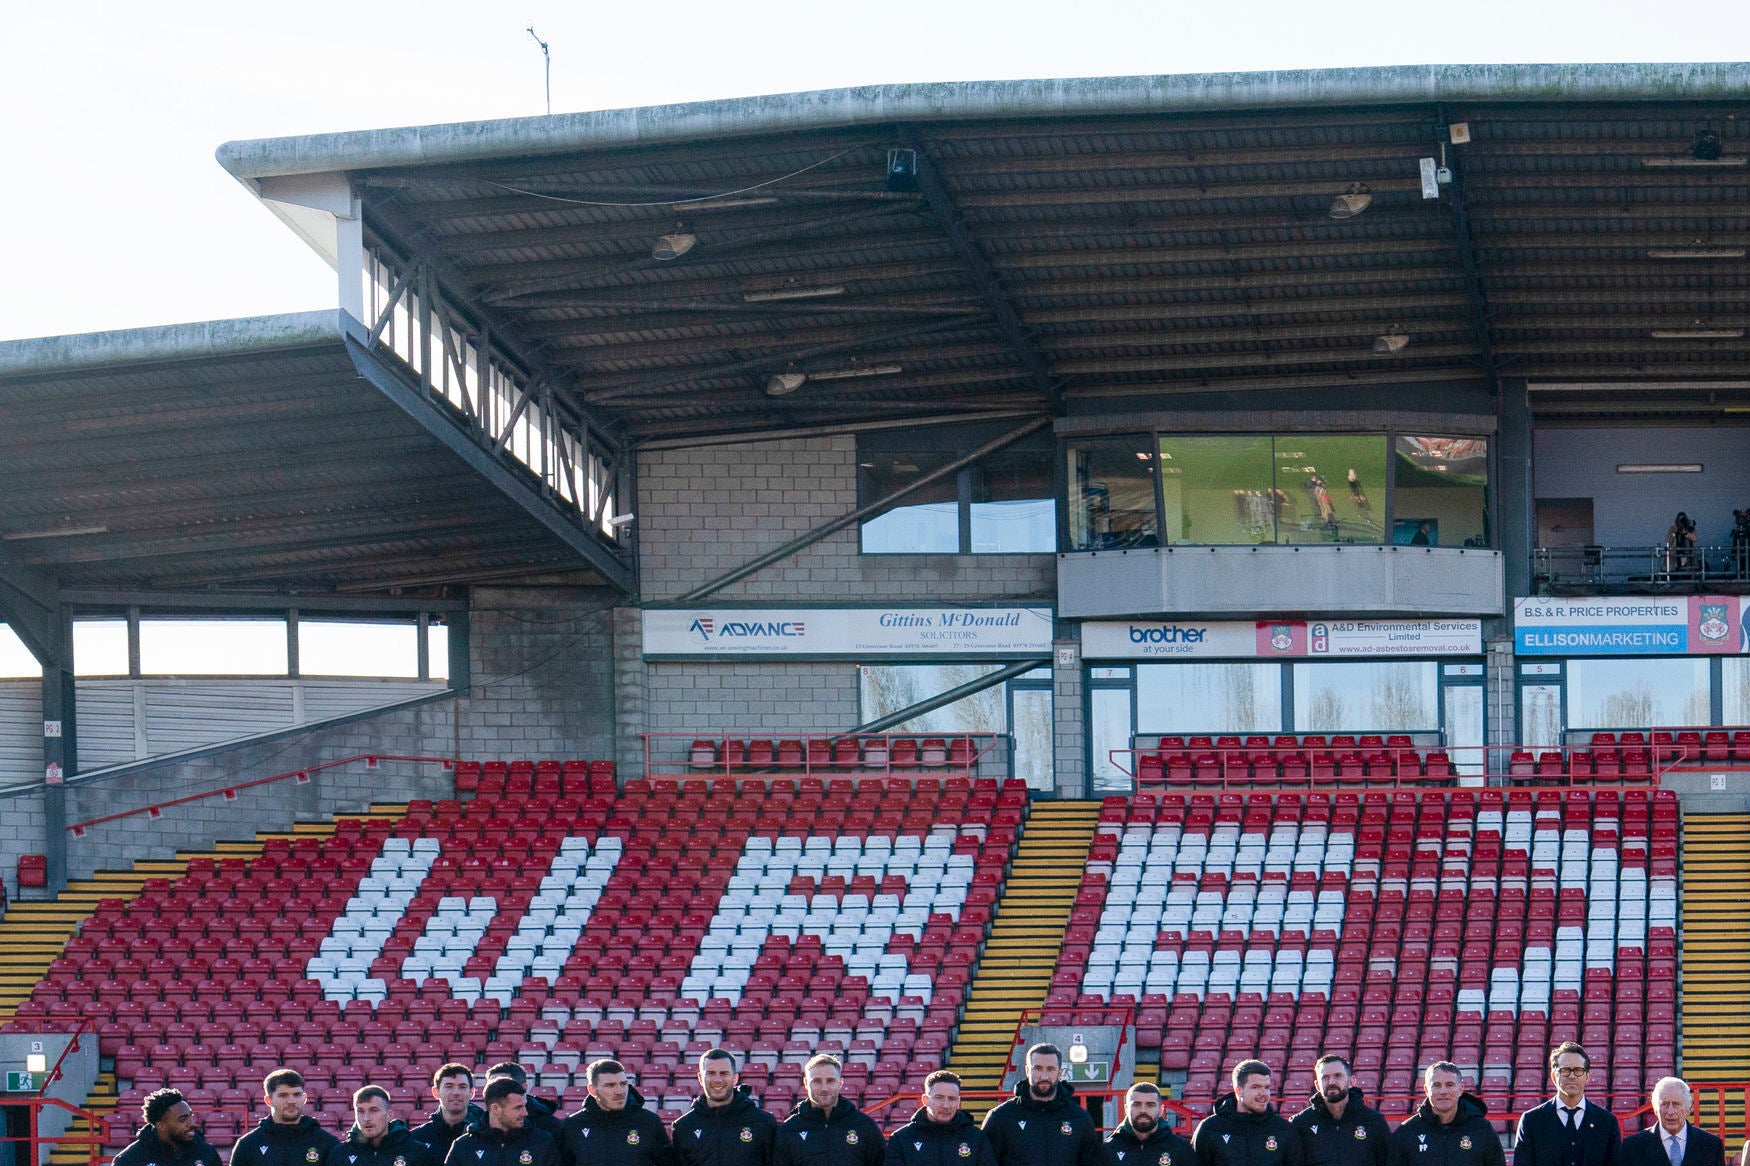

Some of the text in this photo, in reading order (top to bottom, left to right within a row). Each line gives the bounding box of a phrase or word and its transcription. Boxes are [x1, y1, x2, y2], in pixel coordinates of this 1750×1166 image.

[1545, 607, 1553, 617] &
[1556, 607, 1566, 617] R.
[1569, 606, 1603, 617] PRICE
[1606, 606, 1678, 616] PROPERTIES
[879, 612, 1020, 627] Gittins McDonald
[719, 622, 805, 636] ADVANCE
[1332, 622, 1478, 632] A&D Environmental Services
[920, 631, 978, 640] SOLICITORS
[1129, 625, 1206, 643] brother
[1388, 632, 1421, 641] Limited
[1143, 644, 1194, 656] at your side
[1338, 644, 1471, 653] www.ad-asbestosremoval.co.uk
[1107, 669, 1113, 677] 7
[1537, 665, 1543, 673] 5
[34, 1042, 40, 1051] 3
